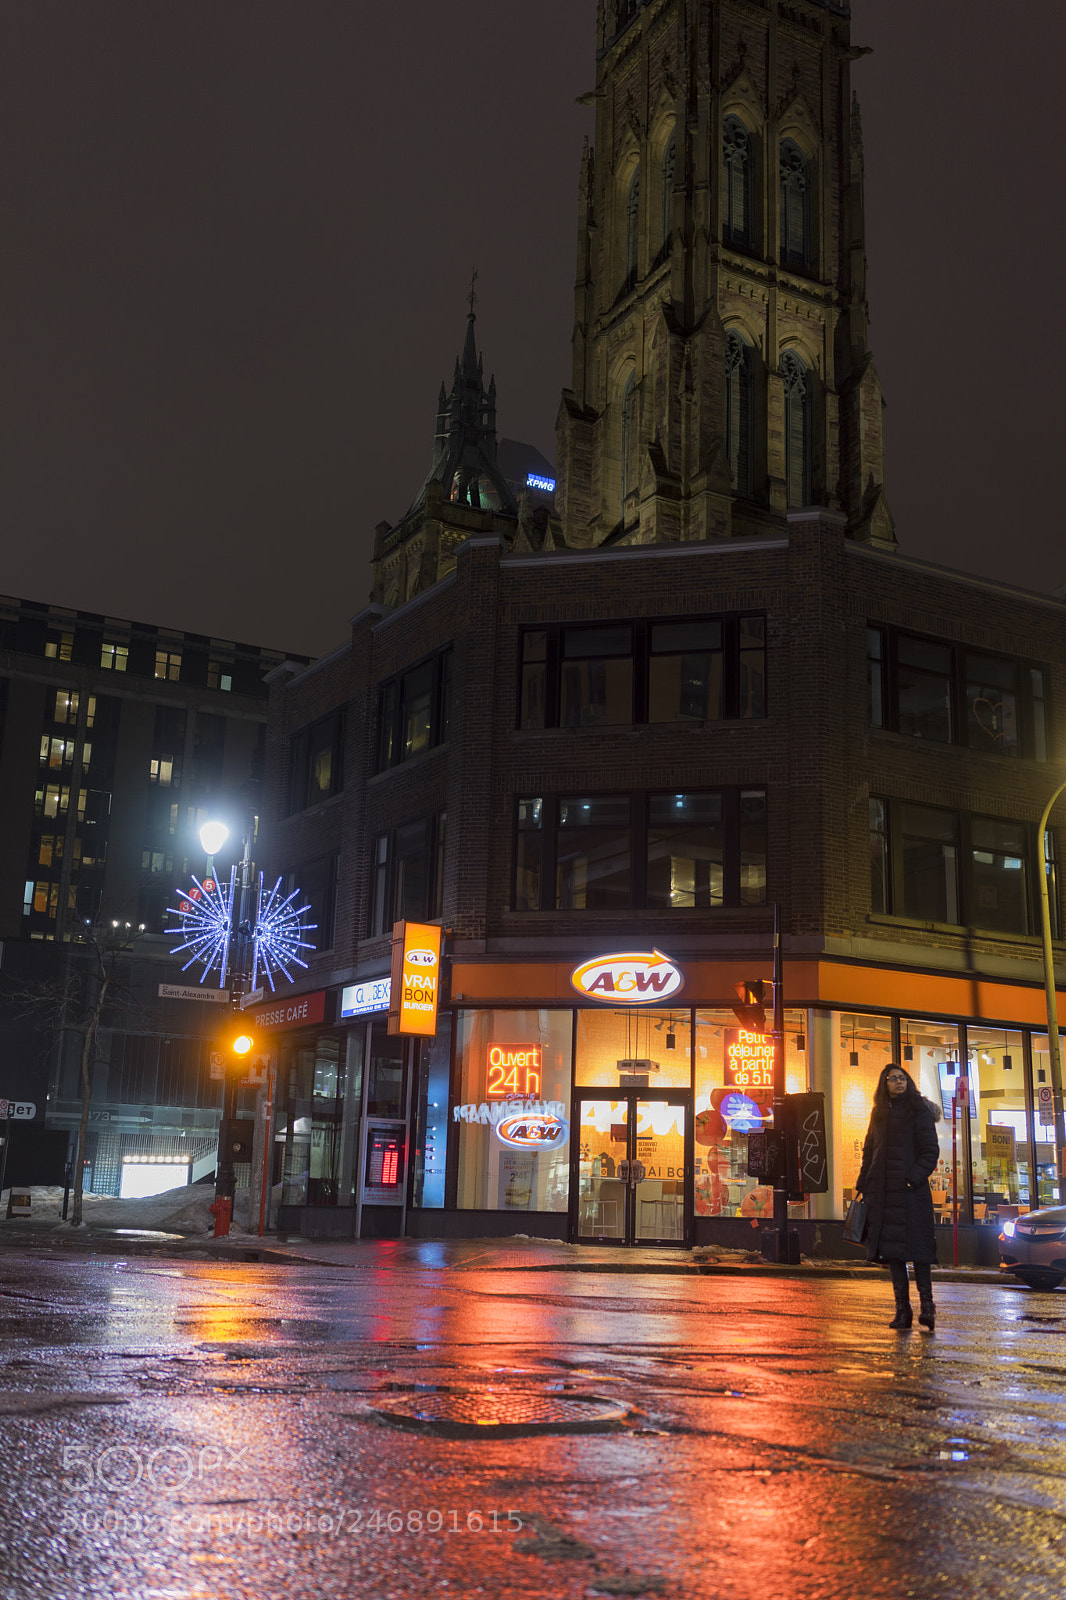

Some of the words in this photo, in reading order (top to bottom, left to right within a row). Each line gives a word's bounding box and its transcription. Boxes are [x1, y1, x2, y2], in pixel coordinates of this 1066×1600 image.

[526, 477, 554, 492] KPMG
[403, 974, 436, 989] VRAI
[585, 970, 674, 992] A&W
[162, 989, 215, 1000] Saint-Alexandre
[404, 988, 434, 1003] BON
[255, 1010, 284, 1028] PRESSE
[286, 1000, 309, 1021] CAFÉ
[403, 1001, 434, 1012] BURGER
[738, 1030, 767, 1044] Petit
[490, 1047, 539, 1067] Ouvert
[730, 1057, 738, 1070] à
[741, 1056, 774, 1072] partir
[487, 1066, 520, 1094] 24
[525, 1067, 540, 1094] h
[735, 1071, 749, 1085] de
[752, 1071, 761, 1085] 5
[763, 1071, 771, 1085] h
[511, 1125, 562, 1141] A&W
